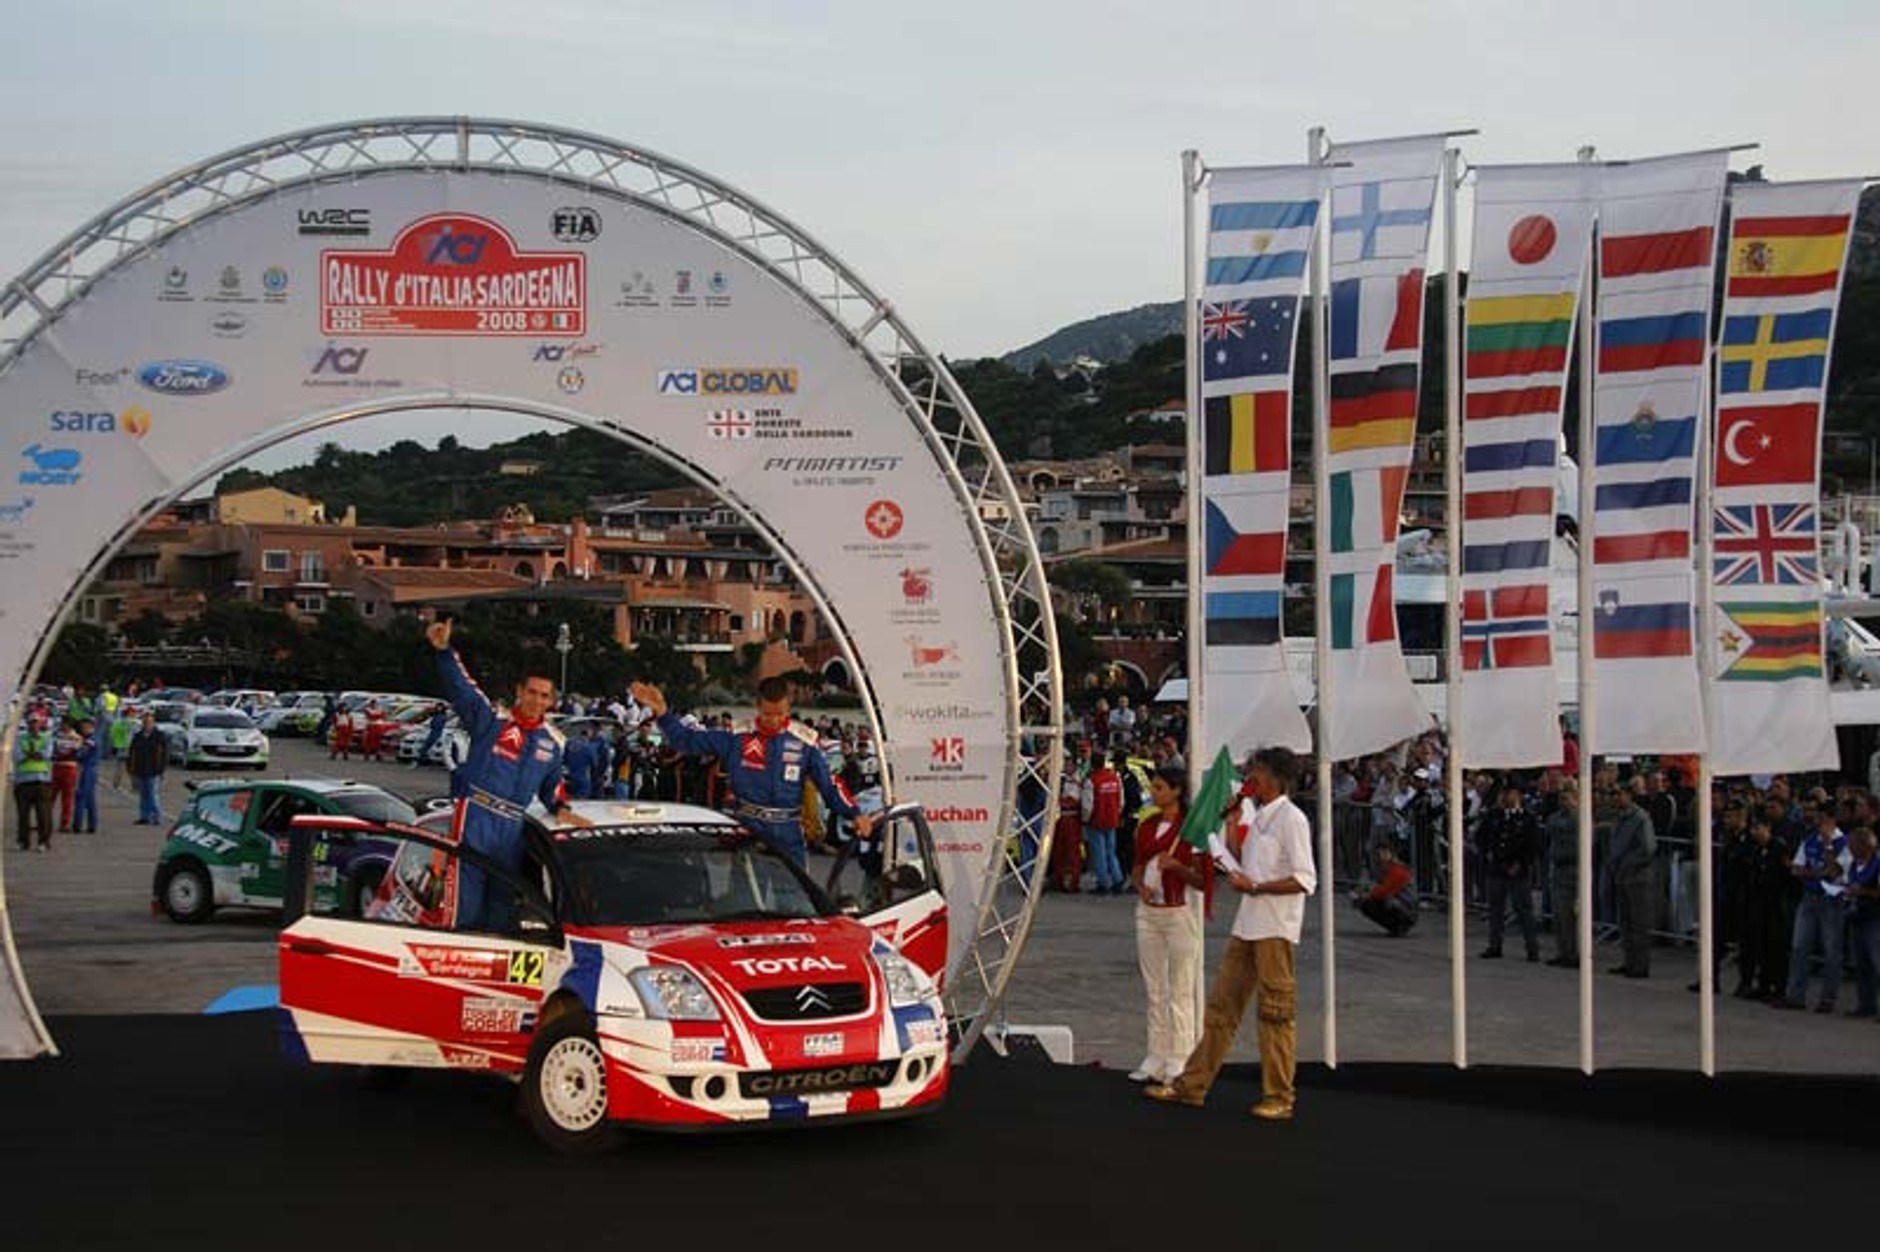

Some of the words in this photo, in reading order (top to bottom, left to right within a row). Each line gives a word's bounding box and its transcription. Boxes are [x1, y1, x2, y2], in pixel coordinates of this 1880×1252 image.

[298, 208, 370, 225] WRC
[553, 214, 597, 235] FIA
[425, 230, 488, 264] ACI
[328, 259, 390, 305] RALLY
[475, 261, 578, 306] SARDEGNA
[476, 311, 528, 330] 2008
[311, 346, 369, 374] ACI
[152, 370, 211, 390] Ford
[659, 373, 697, 394] ACI
[702, 372, 796, 394] GLOBAL
[50, 410, 116, 433] sara
[925, 804, 989, 823] uchan
[510, 951, 543, 984] 42
[730, 956, 847, 977] TOTAL
[749, 1065, 889, 1096] CITROËN
